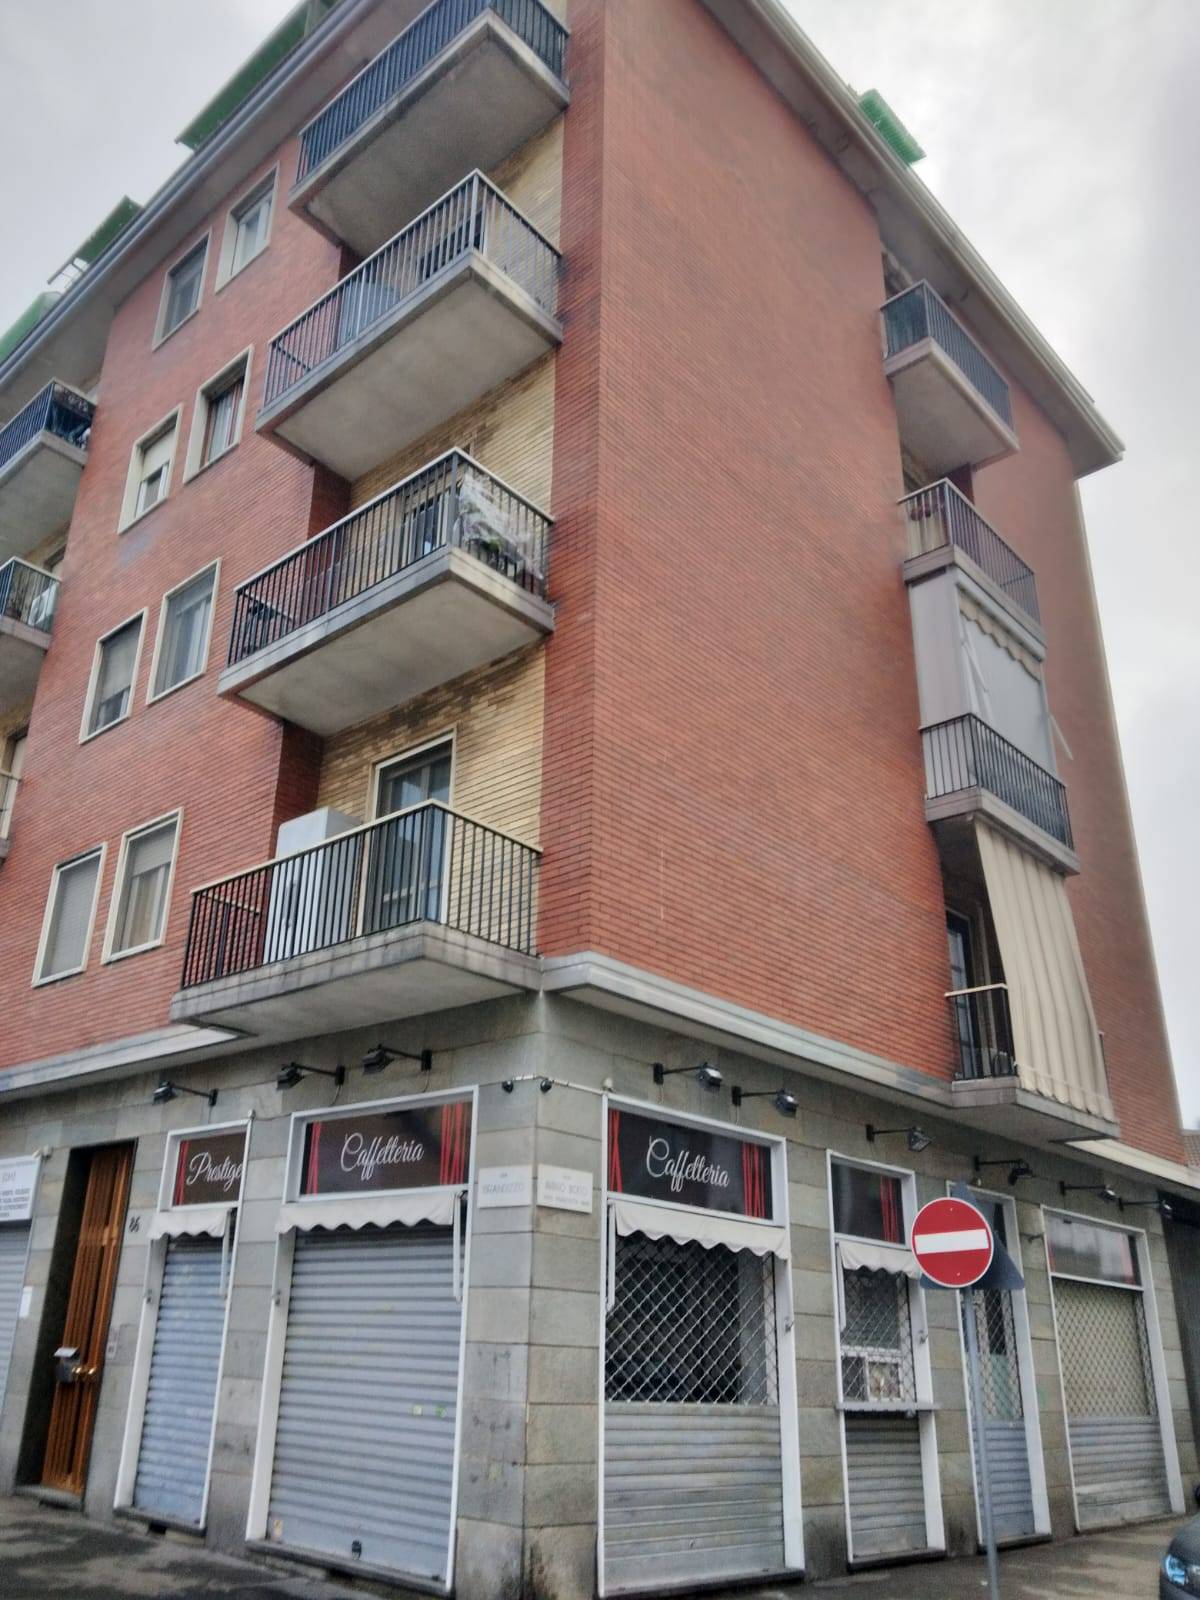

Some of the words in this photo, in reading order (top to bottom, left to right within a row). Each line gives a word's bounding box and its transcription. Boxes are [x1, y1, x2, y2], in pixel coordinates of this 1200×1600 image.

[186, 1151, 243, 1191] Prestige
[340, 1131, 424, 1180] Caffetteria
[646, 1136, 730, 1192] Caffetteria
